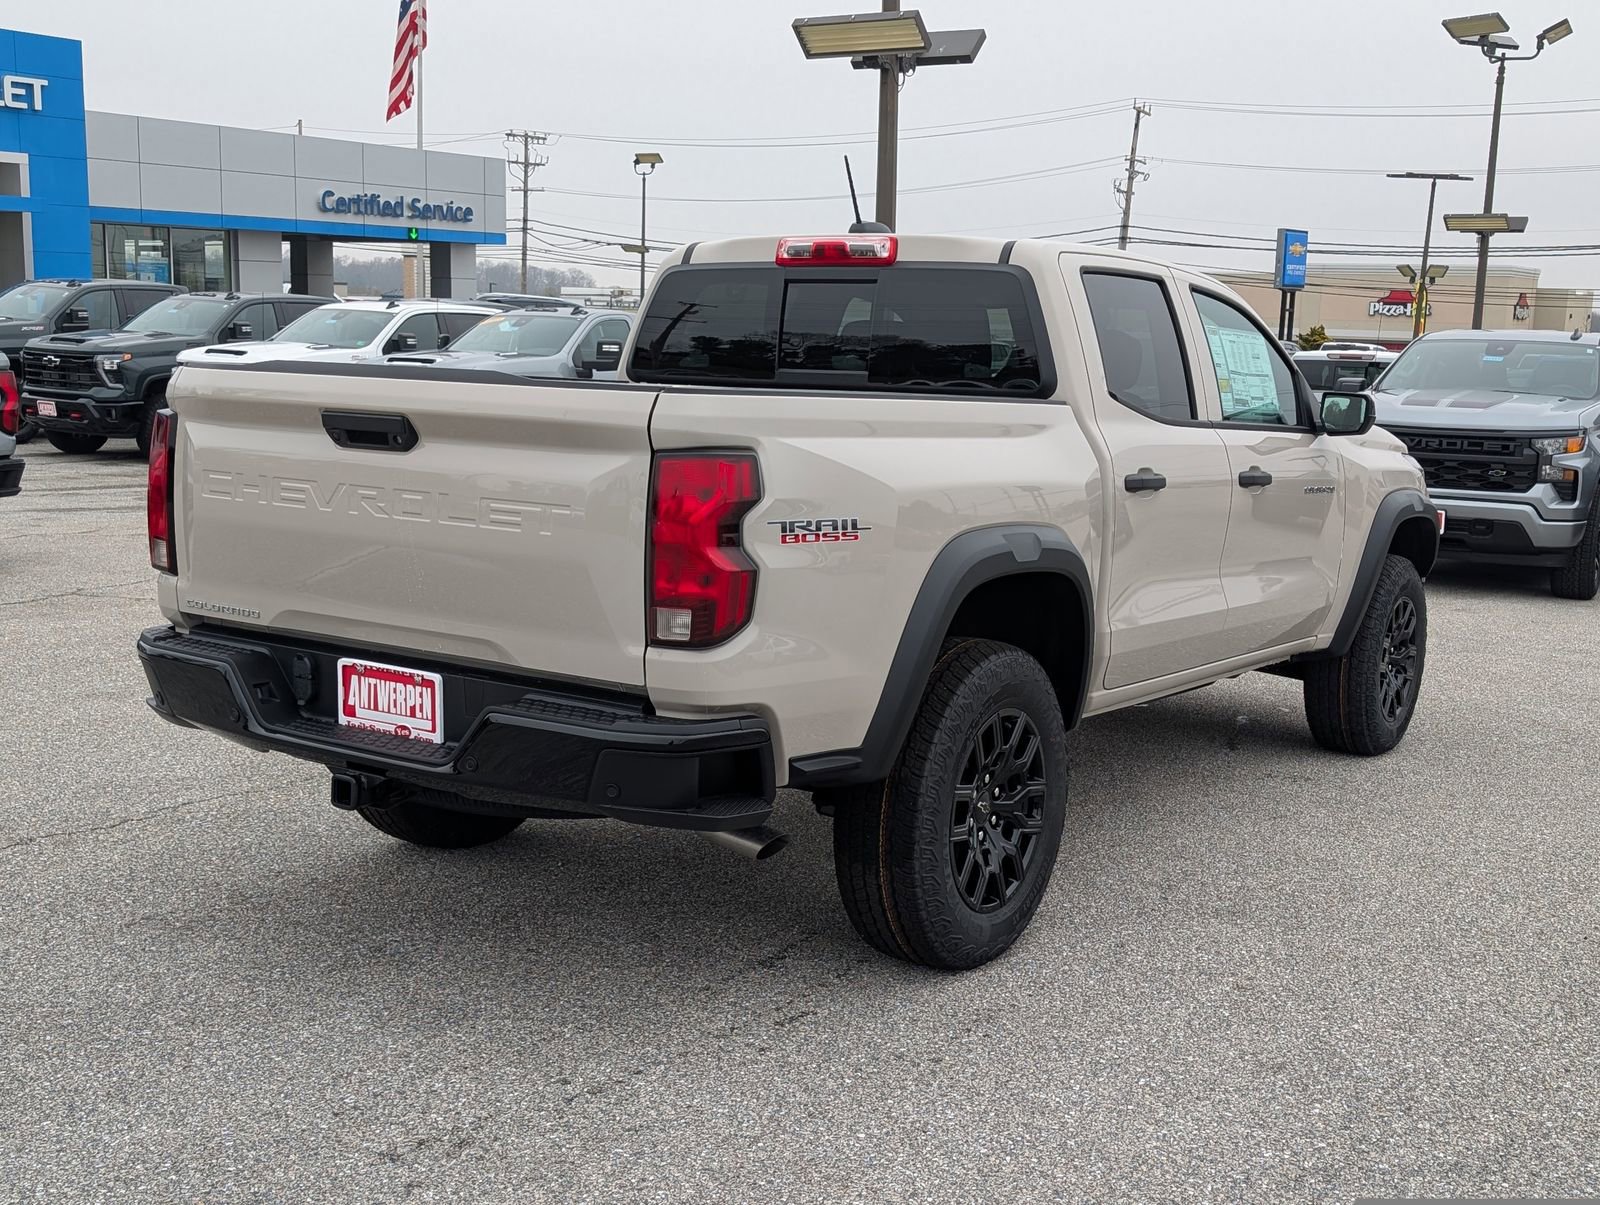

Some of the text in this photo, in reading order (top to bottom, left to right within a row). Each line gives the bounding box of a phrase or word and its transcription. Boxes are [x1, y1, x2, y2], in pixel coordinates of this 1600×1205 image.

[0, 75, 48, 111] ET
[320, 190, 473, 223] Certified Service
[1369, 302, 1404, 316] Pizza
[202, 469, 585, 535] CHEVROLET
[767, 519, 871, 533] TRAIL
[781, 531, 859, 544] BOSS
[186, 600, 261, 619] COLORADO
[348, 675, 432, 720] ANTWERPEN
